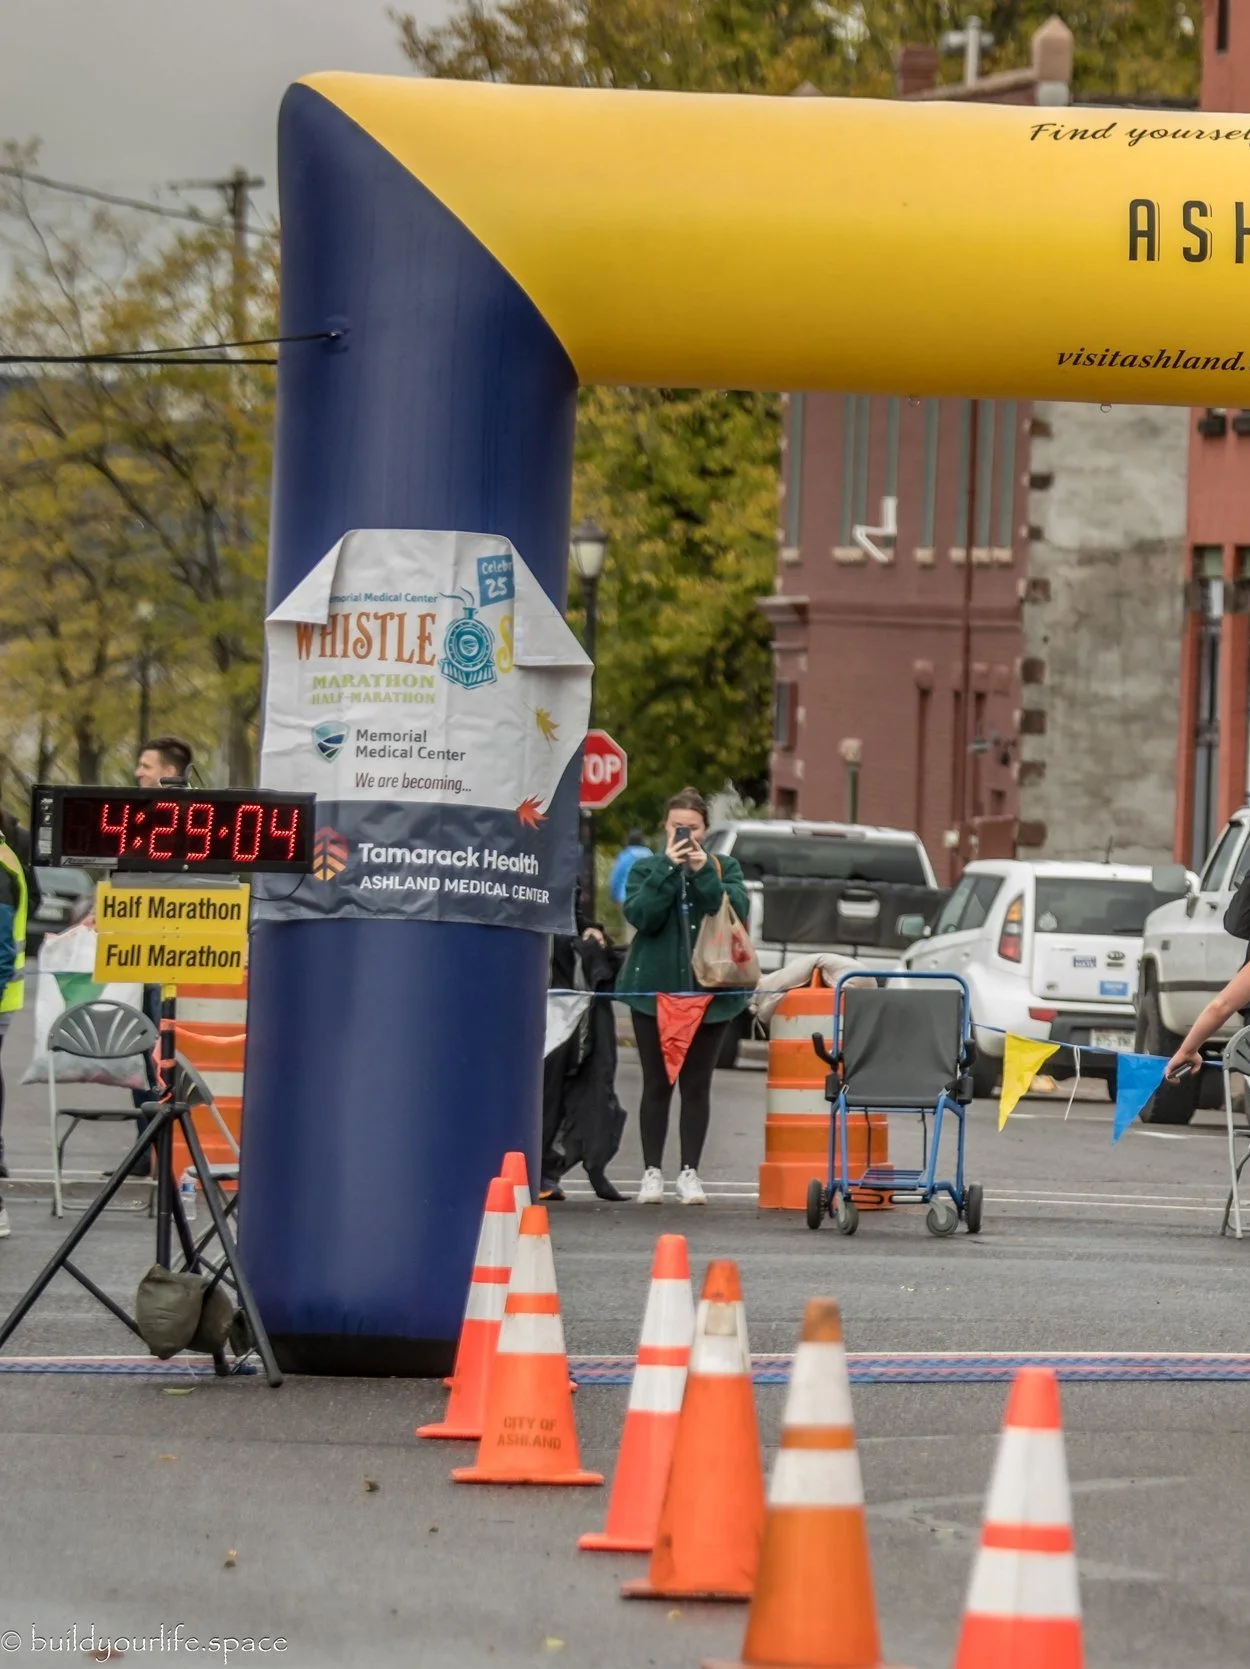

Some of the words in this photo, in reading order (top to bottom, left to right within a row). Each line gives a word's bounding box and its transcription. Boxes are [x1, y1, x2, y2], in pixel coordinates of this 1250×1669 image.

[1029, 122, 1117, 141] Find
[485, 576, 508, 599] 25
[329, 592, 362, 604] morial
[364, 592, 402, 603] Medical
[405, 592, 438, 604] Center
[296, 611, 437, 667] WHISTLE
[312, 673, 436, 689] MARATHON
[311, 691, 436, 705] HALF-MARATHON
[356, 729, 428, 743] Memorial
[355, 745, 413, 759] Medical
[418, 746, 466, 761] Center
[355, 772, 375, 788] We
[378, 775, 399, 788] are
[402, 772, 472, 794] becoming...
[358, 843, 480, 868] Tamarack
[483, 848, 539, 875] Health
[360, 876, 440, 892] ASHLAND
[445, 878, 510, 898] MEDICAL
[512, 885, 550, 905] CENTER
[103, 895, 143, 919] Half
[148, 896, 241, 920] Marathon
[106, 944, 141, 967] Full
[148, 944, 241, 968] Marathon
[503, 1416, 536, 1430] CITY
[540, 1418, 558, 1431] OF
[497, 1434, 562, 1450] ASHLAND
